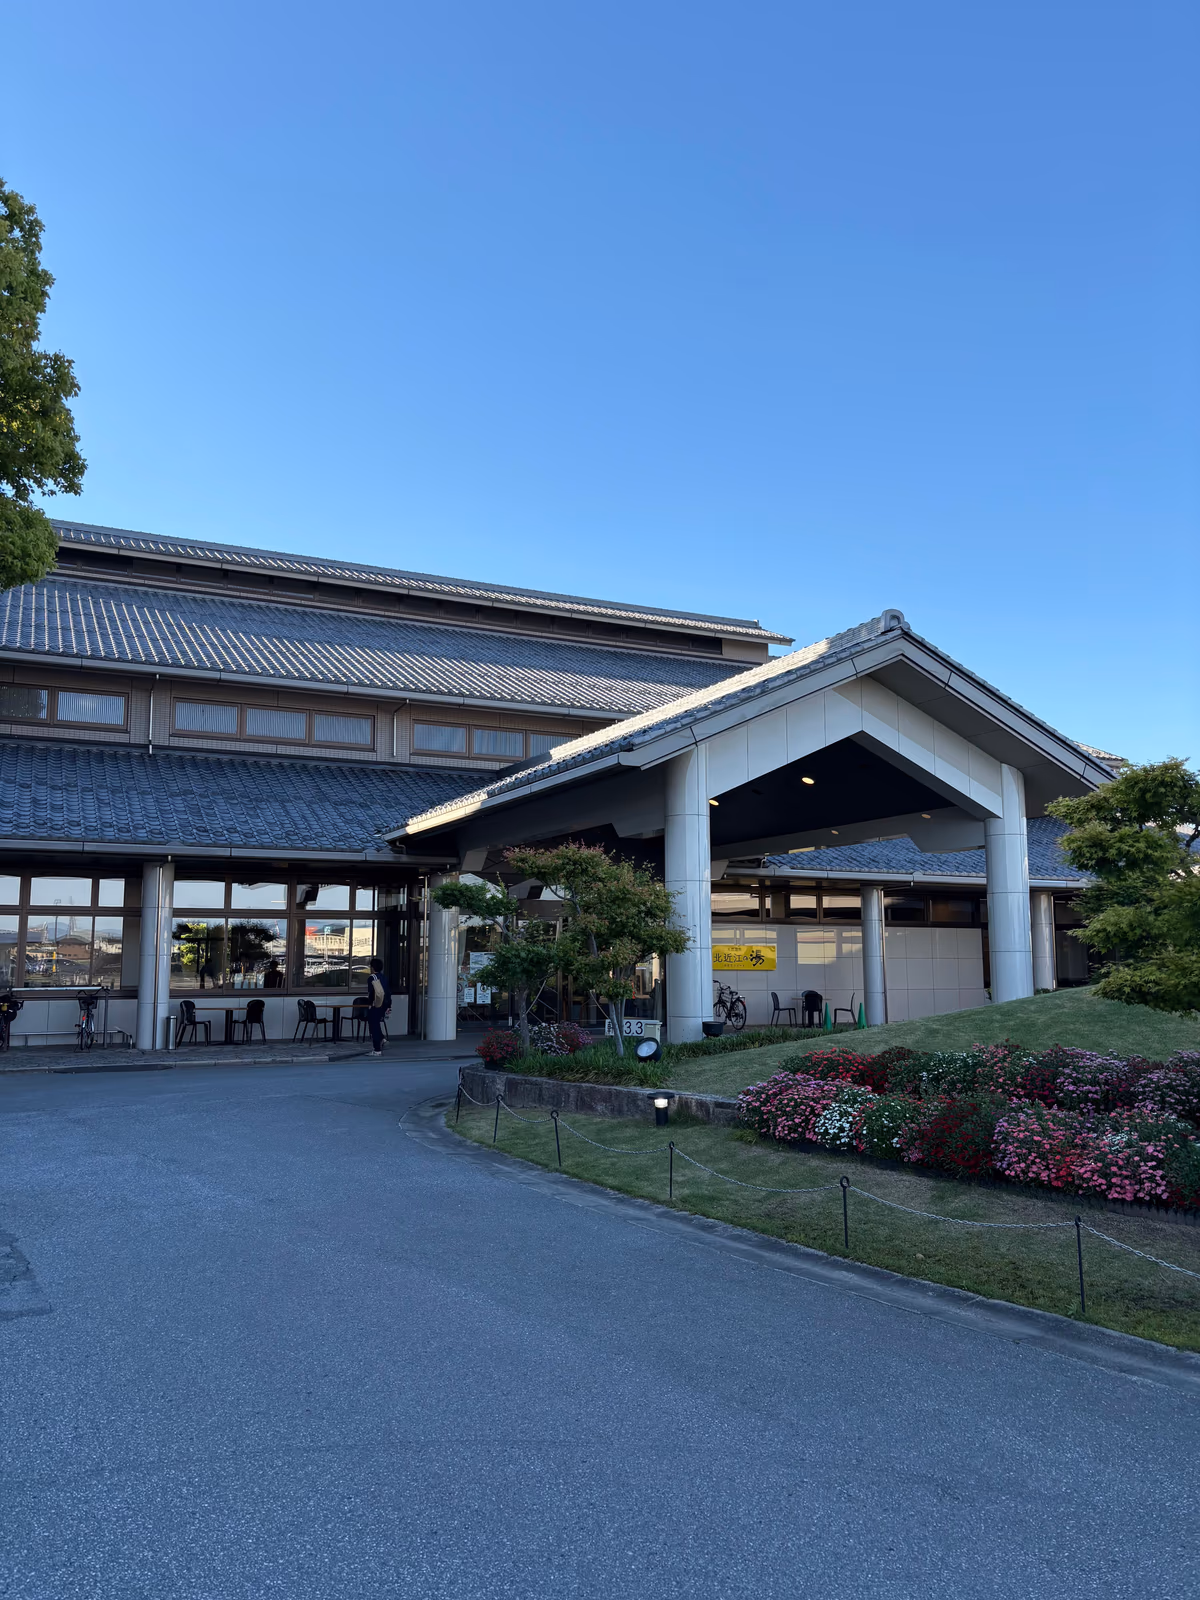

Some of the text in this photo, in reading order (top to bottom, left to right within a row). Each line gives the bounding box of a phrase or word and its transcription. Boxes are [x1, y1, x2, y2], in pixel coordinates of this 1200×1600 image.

[713, 949, 765, 967] 北近江の湯
